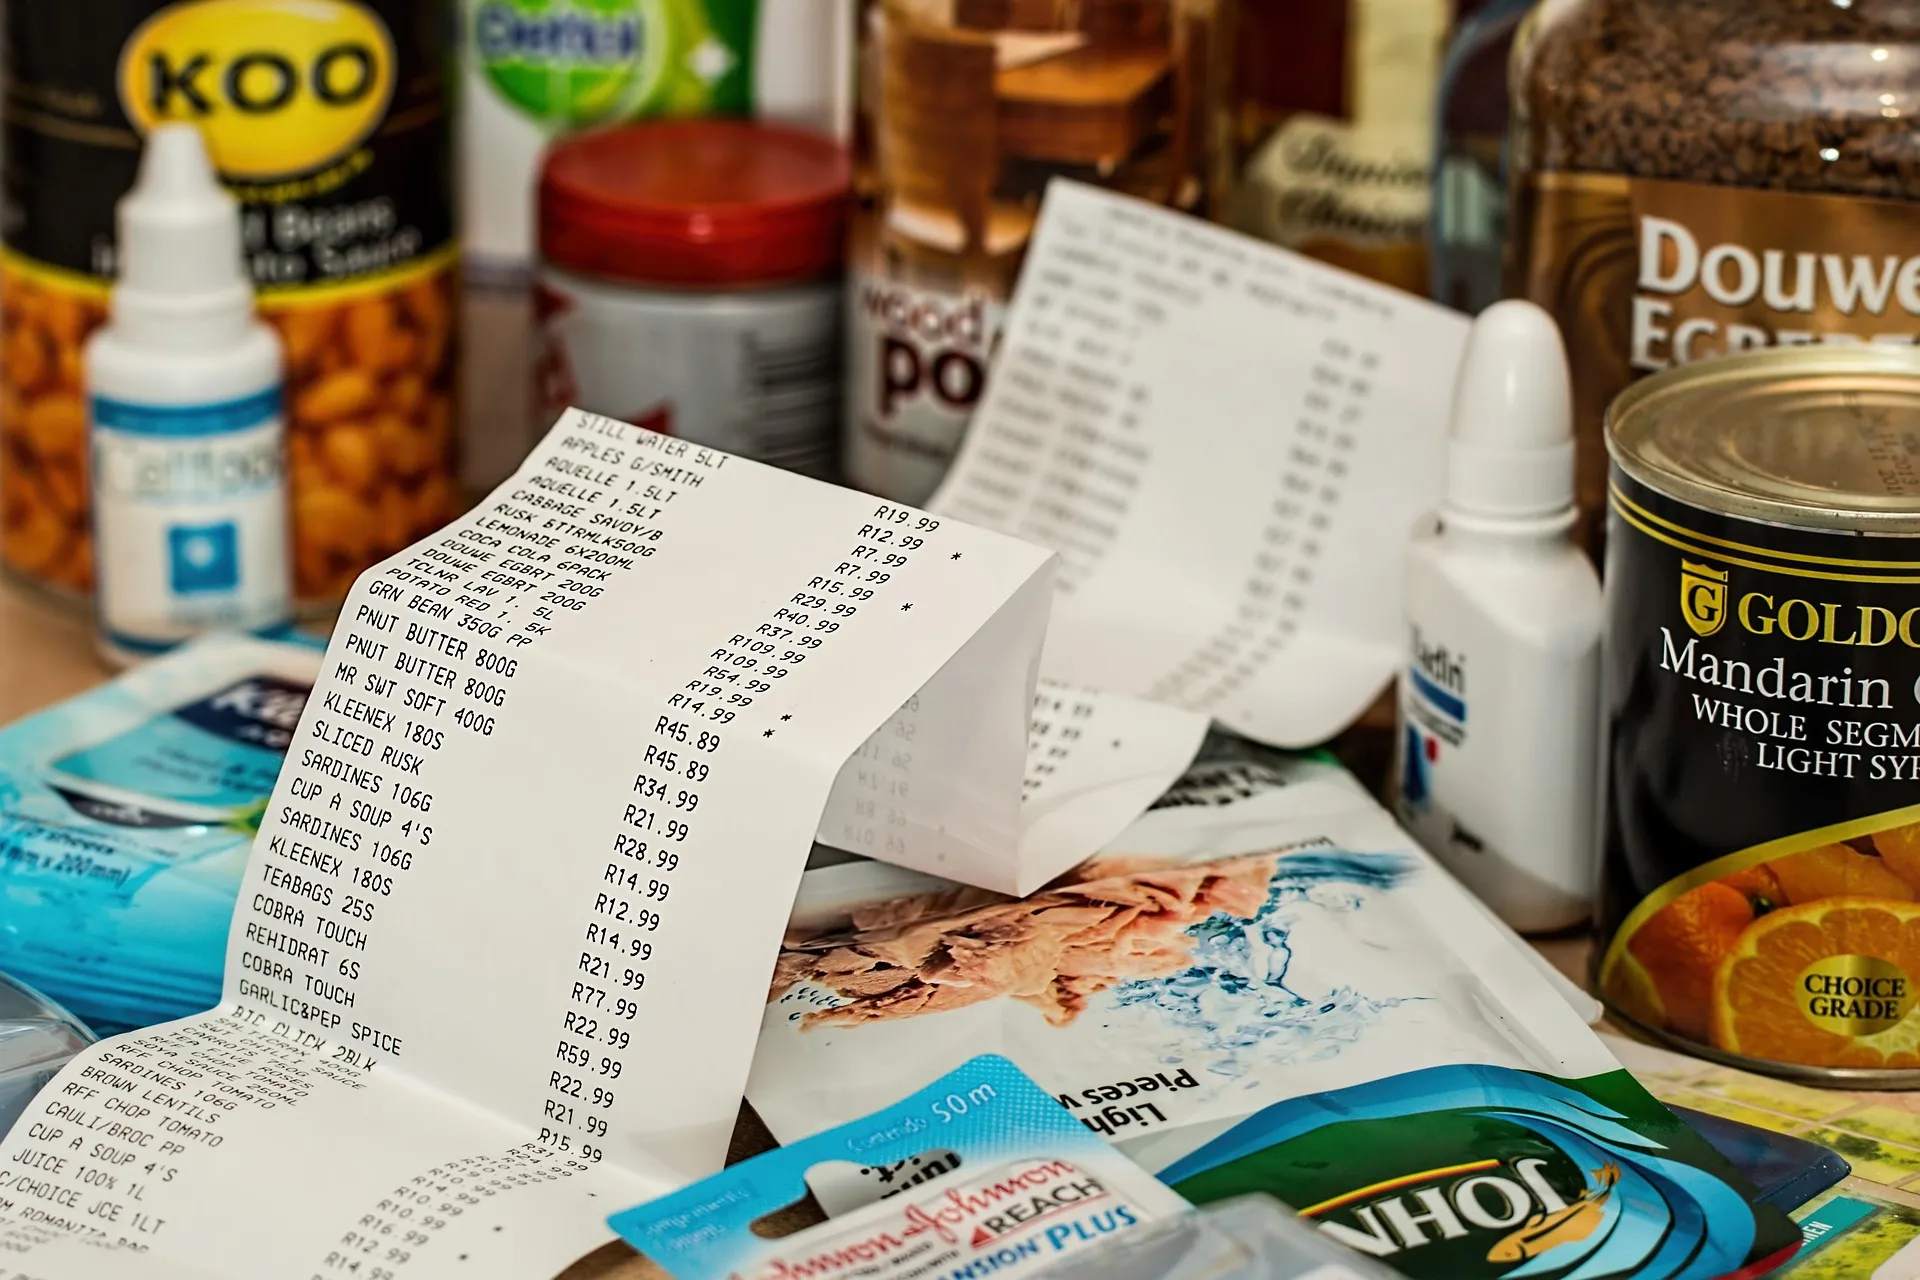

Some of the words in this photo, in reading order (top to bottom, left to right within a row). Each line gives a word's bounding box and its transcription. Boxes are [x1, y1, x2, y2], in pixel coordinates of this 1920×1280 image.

[149, 43, 377, 117] KOO
[545, 457, 619, 487] AQUELLE
[851, 545, 908, 568] R7.99
[561, 436, 625, 465] APPLES
[629, 457, 705, 488] G/SMITH
[857, 524, 924, 550] R12.99
[577, 413, 625, 440] STILL
[636, 435, 689, 458] WATER
[695, 450, 729, 470] 5LT
[874, 505, 940, 532] R19.99
[476, 517, 560, 548] LEMONADE
[565, 545, 634, 571] 6X200ML
[773, 607, 840, 634] R40.99
[494, 503, 538, 523] RUSK
[790, 592, 857, 618] R29.99
[511, 490, 585, 518] CABBAGE
[590, 513, 663, 541] SAVOY/B
[807, 576, 874, 601] R15.99
[528, 475, 602, 503] AQUELLE
[834, 562, 891, 585] R7.99
[386, 568, 451, 596] POTATO
[455, 594, 491, 612] RED
[685, 680, 753, 707] R19.99
[407, 558, 459, 583] TCLNR
[463, 581, 499, 597] LAV
[703, 665, 771, 693] R54.99
[423, 549, 478, 573] DOUWE
[481, 571, 537, 593] EGBRT
[540, 591, 587, 611] 200G
[711, 649, 788, 679] R109.99
[441, 539, 496, 562] DOUWE
[499, 559, 555, 582] EGBRT
[558, 579, 605, 598] 200G
[728, 634, 806, 664] R109.99
[459, 529, 502, 548] COCA
[508, 545, 551, 562] COLA
[556, 561, 612, 581] 6PACK
[756, 623, 823, 650] R37.99
[1688, 584, 1719, 622] G
[356, 604, 399, 633] PNUT
[405, 622, 468, 660] BUTTER
[475, 648, 517, 678] 800G
[655, 715, 721, 753] R45.89
[369, 580, 404, 602] GRN
[407, 595, 453, 621] BEAN
[458, 614, 503, 638] 350G
[506, 633, 532, 648] PP
[667, 693, 736, 724] R14.99
[1660, 626, 1893, 709] Mandarin
[335, 662, 357, 685] MR
[364, 674, 397, 699] SWT
[404, 688, 446, 717] SOFT
[454, 708, 495, 736] 400G
[633, 774, 699, 812] R34.99
[346, 634, 388, 661] PNUT
[394, 652, 457, 689] BUTTER
[464, 678, 506, 707] 800G
[644, 745, 709, 782] R45.89
[1692, 693, 1807, 741] WHOLE
[1756, 741, 1861, 778] LIGHT
[312, 720, 374, 756] SLICED
[381, 746, 424, 776] RUSK
[614, 833, 679, 871] R28.99
[323, 691, 396, 733] KLEENEX
[404, 721, 445, 750] 180S
[623, 804, 689, 842] R21.99
[290, 778, 322, 801] CUP
[329, 792, 341, 811] A
[350, 800, 392, 828] SOUP
[401, 820, 433, 846] 4'S
[594, 893, 660, 931] R12.99
[302, 749, 383, 793] SARDINES
[392, 783, 432, 812] 106G
[604, 864, 669, 901] R14.99
[269, 835, 342, 878] KLEENEX
[353, 867, 393, 896] 180S
[579, 952, 645, 990] R21.99
[280, 807, 362, 851] SARDINES
[372, 841, 412, 870] 106G
[586, 923, 652, 961] R14.99
[253, 894, 305, 927] COBRA
[316, 917, 368, 951] TOUCH
[563, 1011, 630, 1050] R22.99
[263, 864, 333, 906] TEABAGS
[342, 896, 375, 922] 25S
[571, 981, 638, 1020] R77.99
[1804, 973, 1905, 998] CHOICE
[183, 1027, 258, 1057] CARROTS
[267, 1059, 309, 1077] 750G
[242, 952, 293, 984] COBRA
[305, 975, 355, 1008] TOUCH
[550, 1071, 614, 1108] R22.99
[246, 923, 329, 967] REHIDRAT
[339, 959, 361, 980] 6S
[556, 1041, 622, 1079] R59.99
[1809, 996, 1898, 1020] GRADE
[81, 1066, 138, 1093] BROWN
[142, 1089, 220, 1124] LENTILS
[99, 1053, 186, 1090] SARDINES
[195, 1090, 237, 1111] 106G
[116, 1044, 153, 1058] RFF
[158, 1060, 203, 1079] CHOP
[211, 1080, 276, 1109] TOMATO
[133, 1039, 177, 1057] SOYA
[185, 1059, 242, 1082] SAUCE
[246, 1083, 299, 1107] 250ML
[169, 1032, 199, 1046] TEA
[207, 1047, 253, 1065] FIVE
[258, 1066, 314, 1089] ROSES
[191, 1051, 236, 1068] CHOP
[245, 1070, 308, 1097] TOMATO
[232, 1006, 266, 1027] BIC
[272, 1022, 327, 1051] CLICK
[332, 1046, 377, 1072] 2BLK
[537, 1127, 602, 1163] R15.99
[239, 979, 341, 1029] GARLIC&PEP
[351, 1023, 402, 1056] SPICE
[544, 1099, 607, 1138] R21.99
[240, 1038, 306, 1064] CHILLI
[311, 1067, 367, 1090] SAUCE
[506, 1148, 572, 1177] R24.99
[1082, 1068, 1200, 1105] Pieces
[12, 1148, 68, 1175] JUICE
[75, 1166, 119, 1190] 100%
[28, 1123, 64, 1142] CUP
[69, 1136, 84, 1150] A
[90, 1143, 136, 1167] SOUP
[144, 1163, 178, 1183] 4'S
[45, 1101, 154, 1148] CAULI/BROC
[158, 1141, 185, 1156] PP
[62, 1082, 100, 1100] RFF
[104, 1097, 151, 1119] CHOP
[158, 1116, 223, 1148] TOMATO
[521, 1143, 588, 1171] R31.99
[88, 1200, 124, 1222] JCE
[131, 1213, 166, 1235] 1LT
[983, 1177, 1106, 1234] REACH
[1044, 1204, 1138, 1252] PLUS
[1317, 1157, 1568, 1257] JOHN
